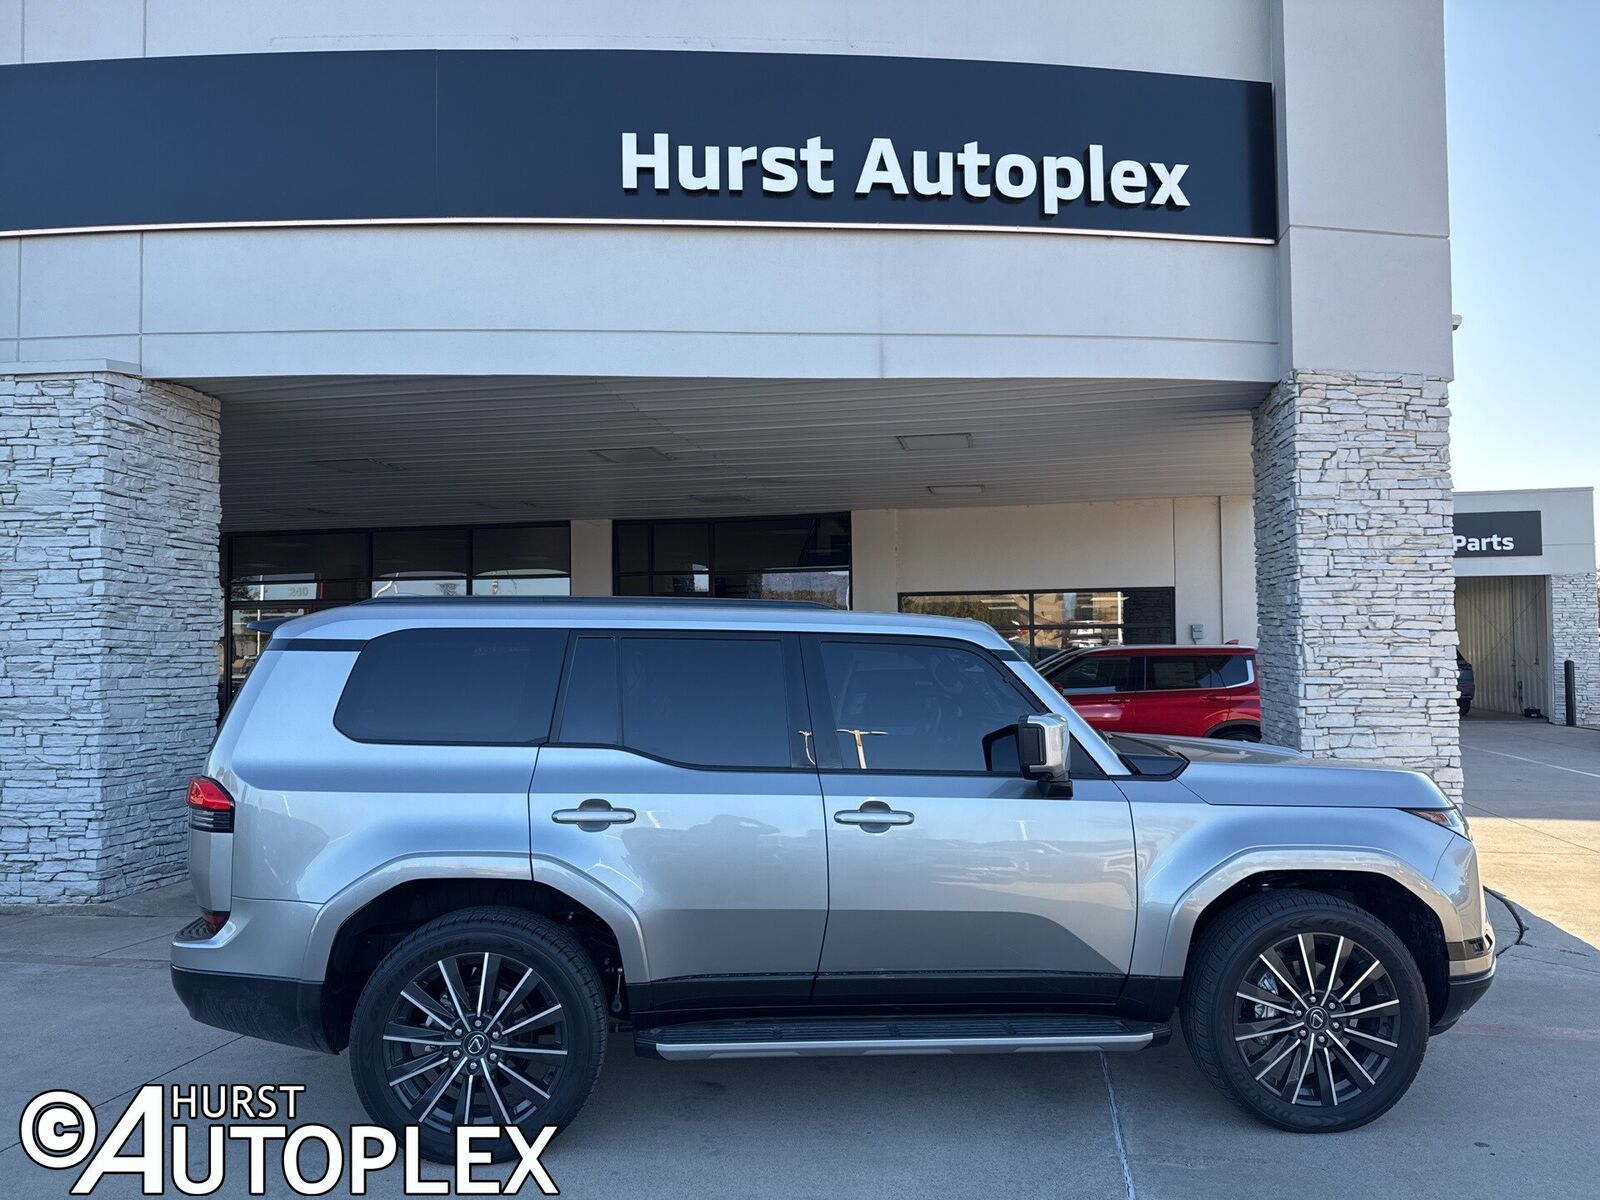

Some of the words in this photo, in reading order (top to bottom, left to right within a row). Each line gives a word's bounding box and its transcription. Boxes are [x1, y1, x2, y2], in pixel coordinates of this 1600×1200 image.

[621, 132, 835, 194] Hurst
[855, 137, 1191, 215] Autoplex
[1453, 533, 1515, 552] Parts
